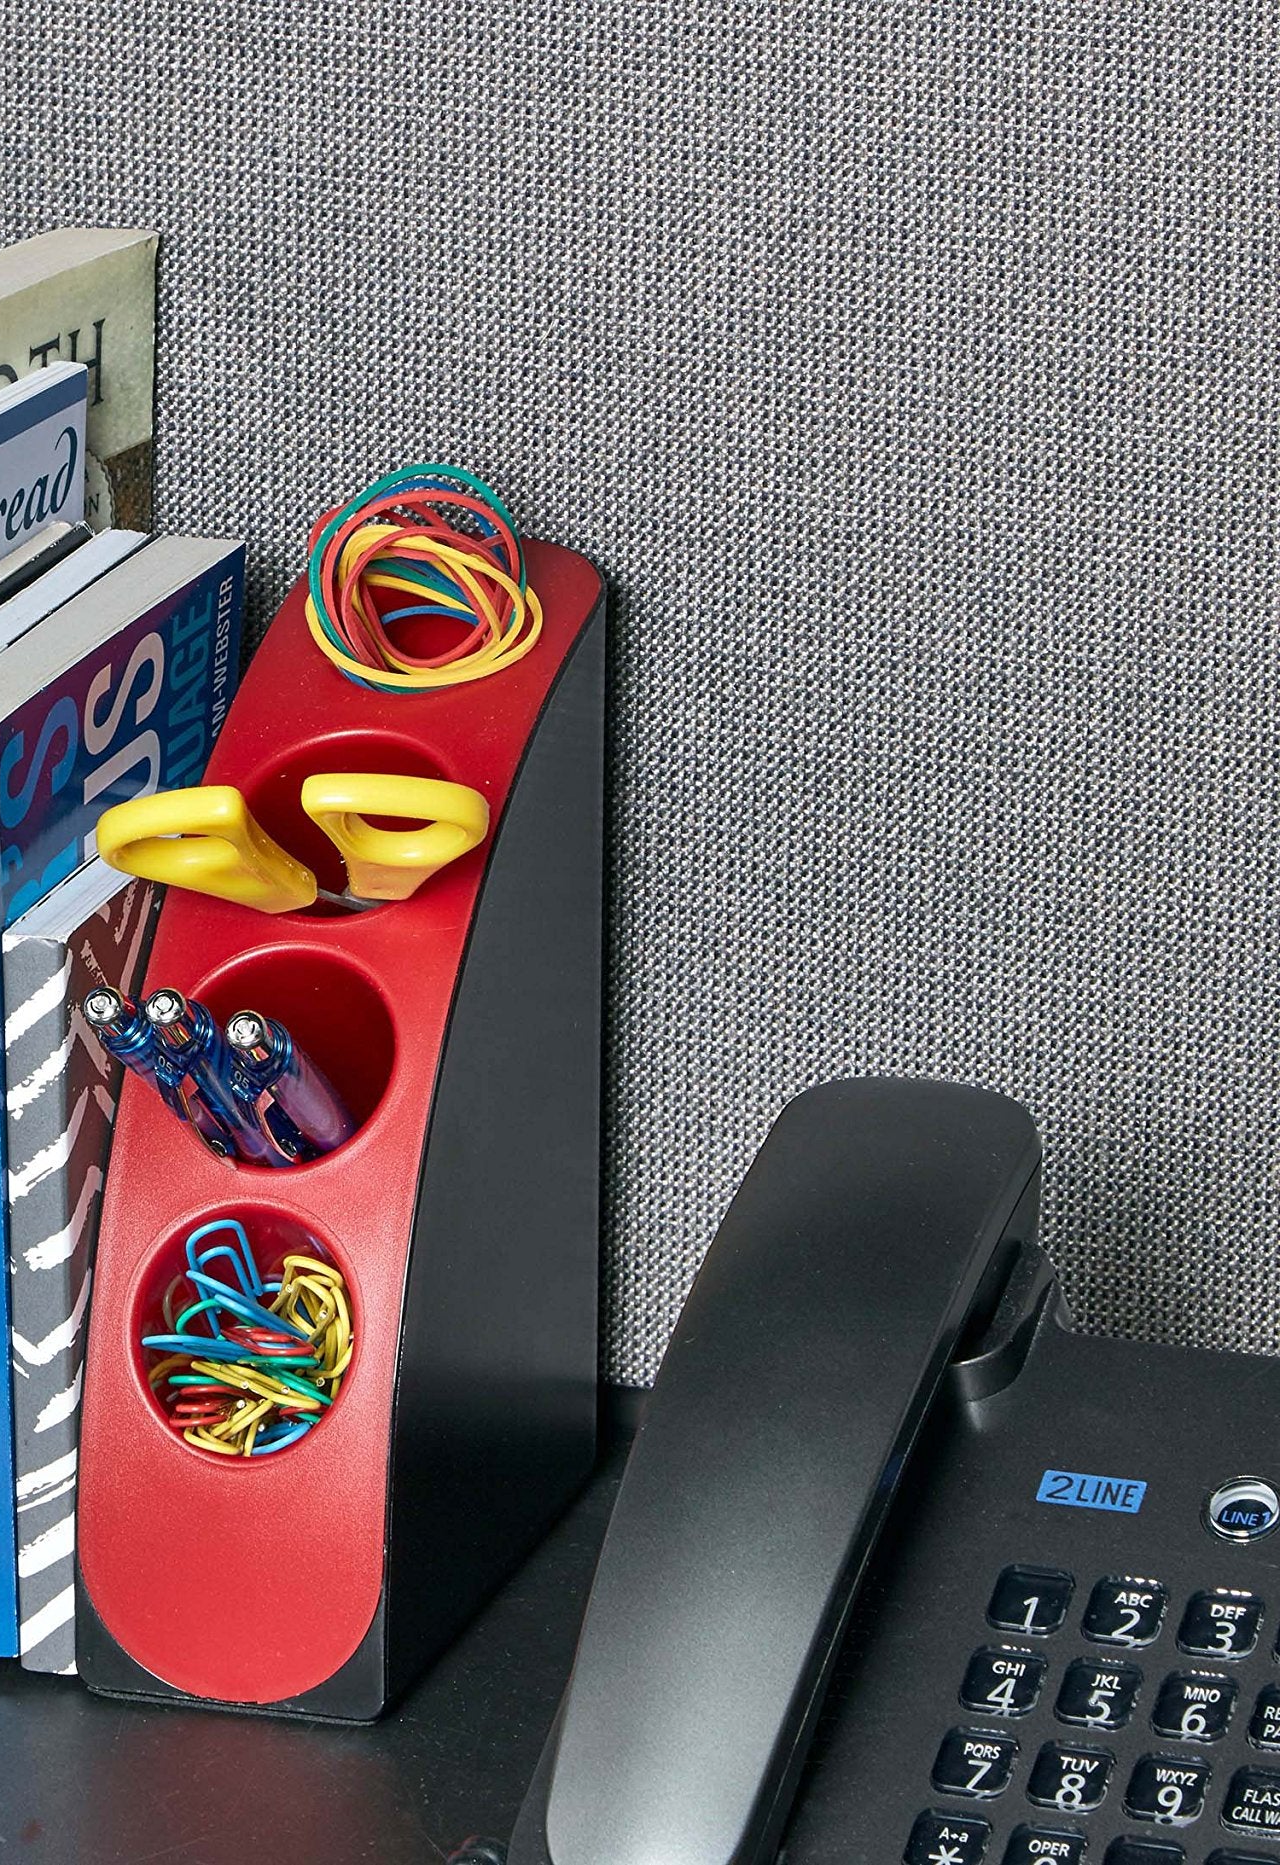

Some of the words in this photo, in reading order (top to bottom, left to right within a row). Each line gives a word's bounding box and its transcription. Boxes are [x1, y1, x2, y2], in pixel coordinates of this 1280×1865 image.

[1222, 1510, 1260, 1526] LINE
[1114, 1592, 1153, 1609] ABC
[1022, 1597, 1040, 1630] 1
[1210, 1604, 1247, 1621] DEF
[1111, 1609, 1140, 1641] 2
[1208, 1622, 1237, 1654] 3
[992, 1661, 1027, 1678] GHI
[1091, 1674, 1122, 1691] JKL
[986, 1679, 1017, 1707] 4
[1183, 1686, 1221, 1703] MNO
[1085, 1691, 1115, 1723] 5
[1181, 1703, 1207, 1736] 6
[963, 1743, 1002, 1760] PQRS
[1059, 1756, 1101, 1774] TUV
[965, 1760, 993, 1791] 7
[1156, 1768, 1199, 1786] WXYZ
[1055, 1773, 1087, 1806] 8
[1157, 1785, 1184, 1818] 9
[1232, 1806, 1261, 1823] CALL
[1028, 1839, 1070, 1857] OPER
